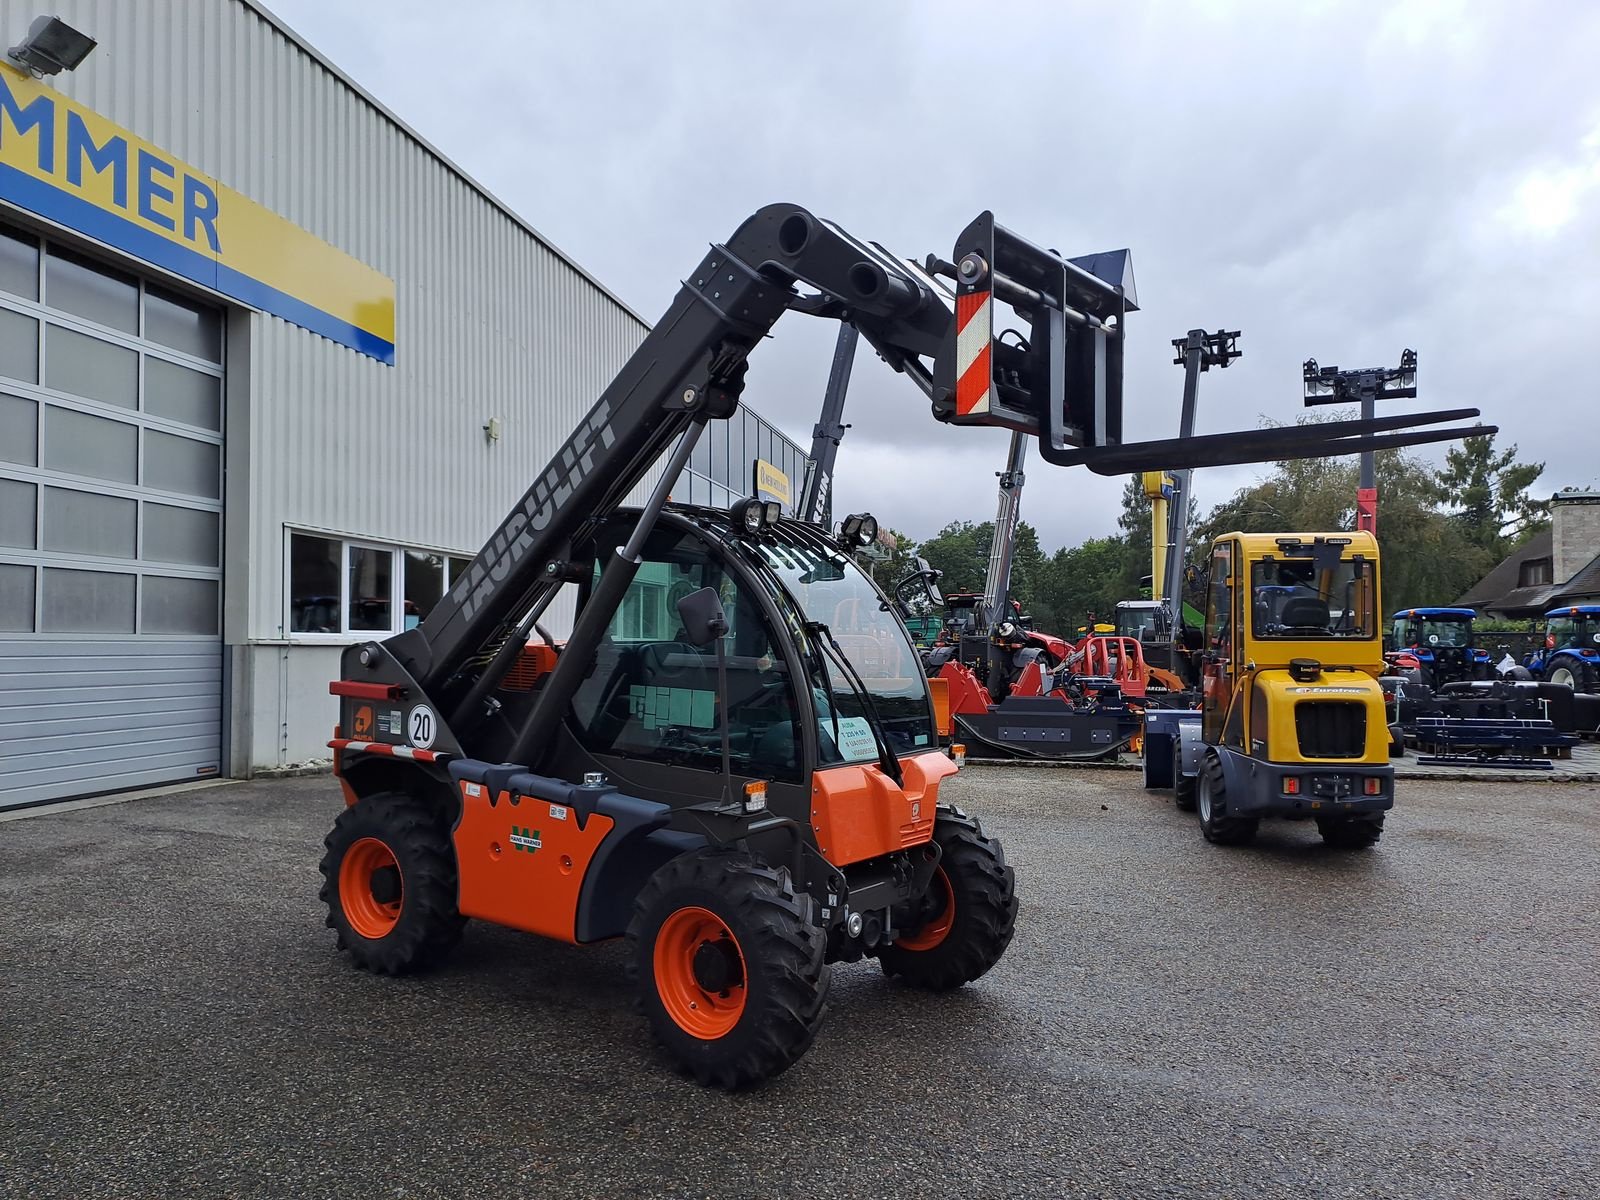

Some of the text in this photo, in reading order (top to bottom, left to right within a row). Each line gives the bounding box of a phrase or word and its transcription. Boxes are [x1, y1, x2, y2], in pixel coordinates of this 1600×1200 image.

[452, 399, 616, 622] TAURULIFT
[414, 712, 431, 742] 20
[523, 838, 540, 847] WARNER
